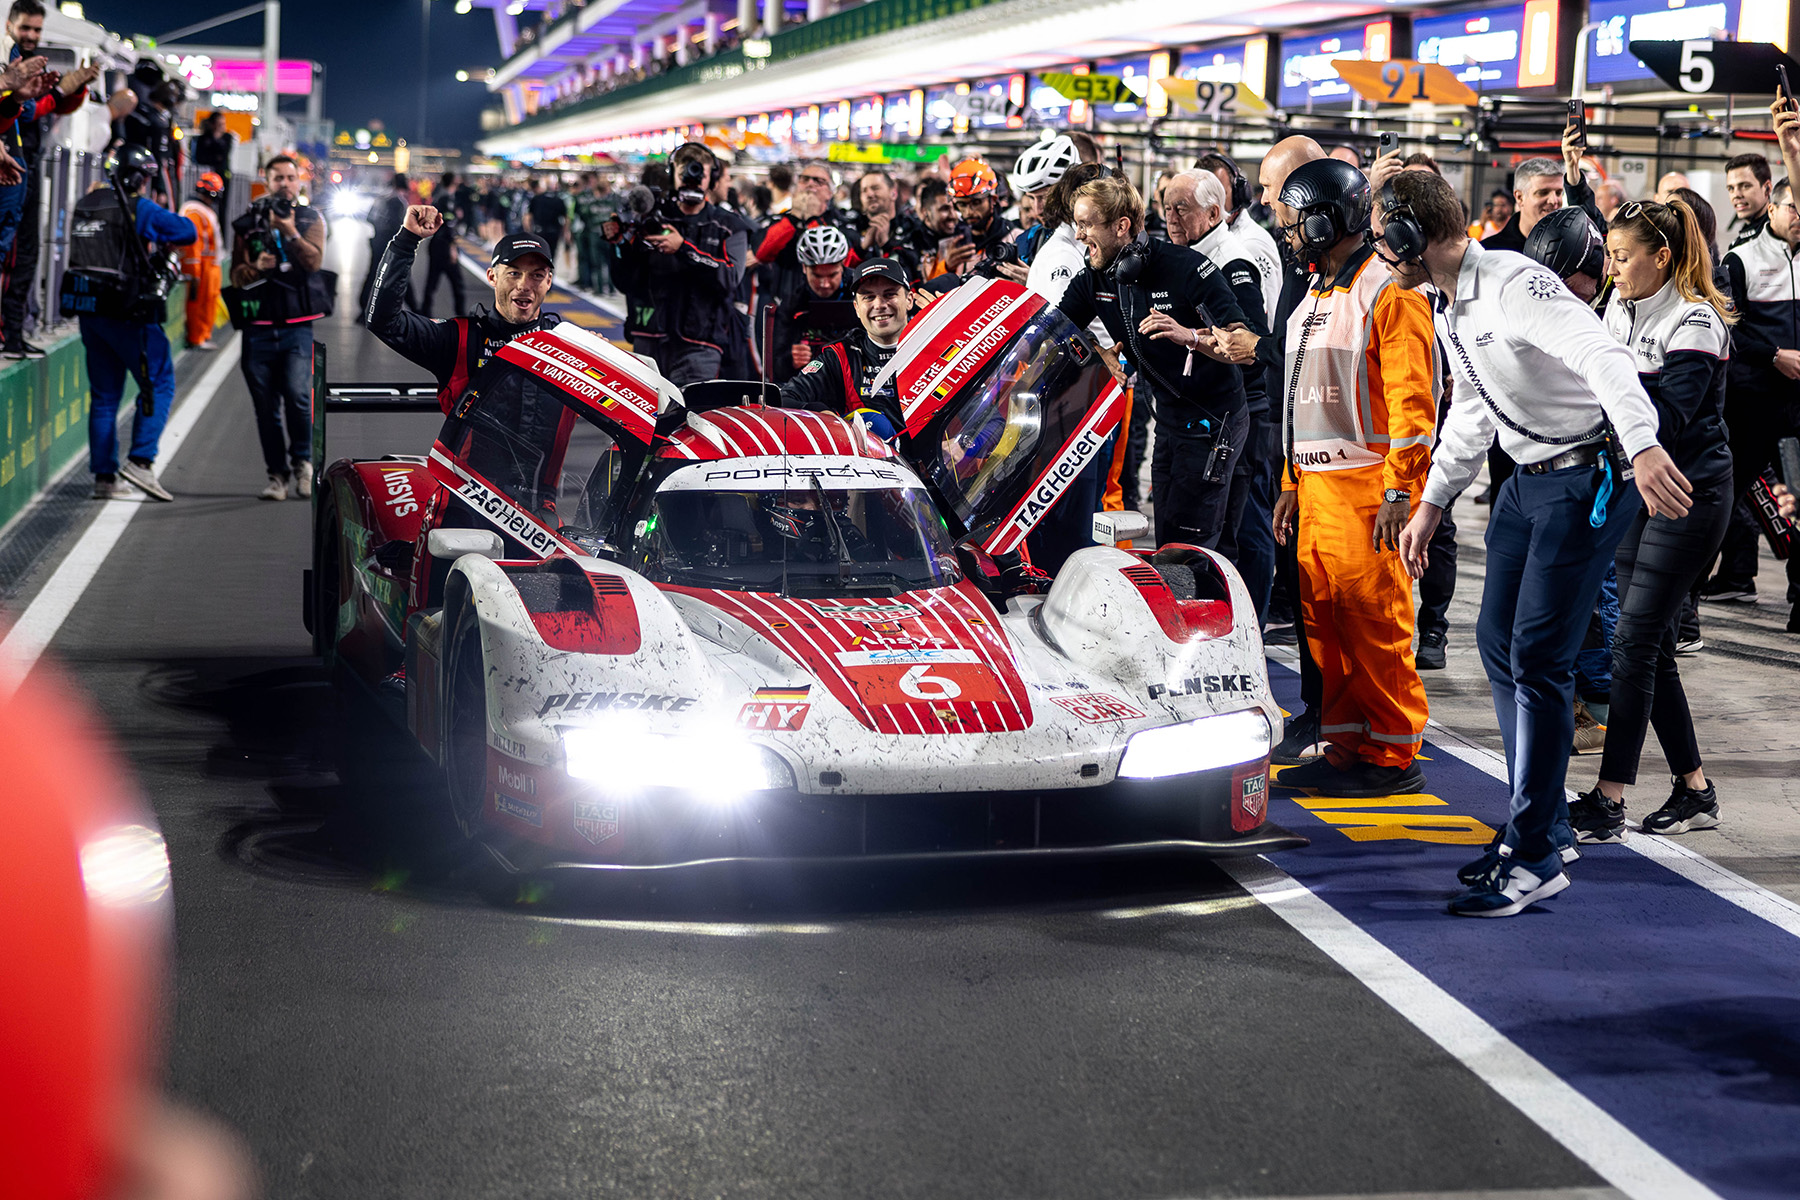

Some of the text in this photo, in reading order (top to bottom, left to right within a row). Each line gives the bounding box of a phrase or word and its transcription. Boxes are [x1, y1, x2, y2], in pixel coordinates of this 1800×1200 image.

[1678, 40, 1714, 93] 5
[1074, 78, 1111, 100] 93
[1382, 61, 1430, 99] 91
[1197, 81, 1237, 113] 92
[1051, 266, 1070, 281] FIA
[1151, 291, 1169, 299] BOSS
[1153, 303, 1172, 311] Ansys
[900, 295, 1014, 407] K. ESTRE A. LOTTERER
[947, 325, 1010, 384] L. VANTHOOR
[522, 337, 656, 413] A. LOTTERER K. ESTRE
[531, 359, 600, 400] L. VANTHOOR
[705, 467, 900, 482] PORSCHE
[380, 468, 418, 517] Ansys
[1095, 521, 1112, 536] HELLER
[852, 636, 947, 646] Ansys
[898, 665, 962, 700] 6
[538, 692, 697, 718] PENSKE
[1057, 694, 1116, 708] HYPER
[1073, 703, 1133, 720] CAR
[493, 733, 526, 759] HELLER
[498, 765, 526, 793] Mobil
[1246, 777, 1264, 793] TAG
[579, 804, 615, 819] TAG
